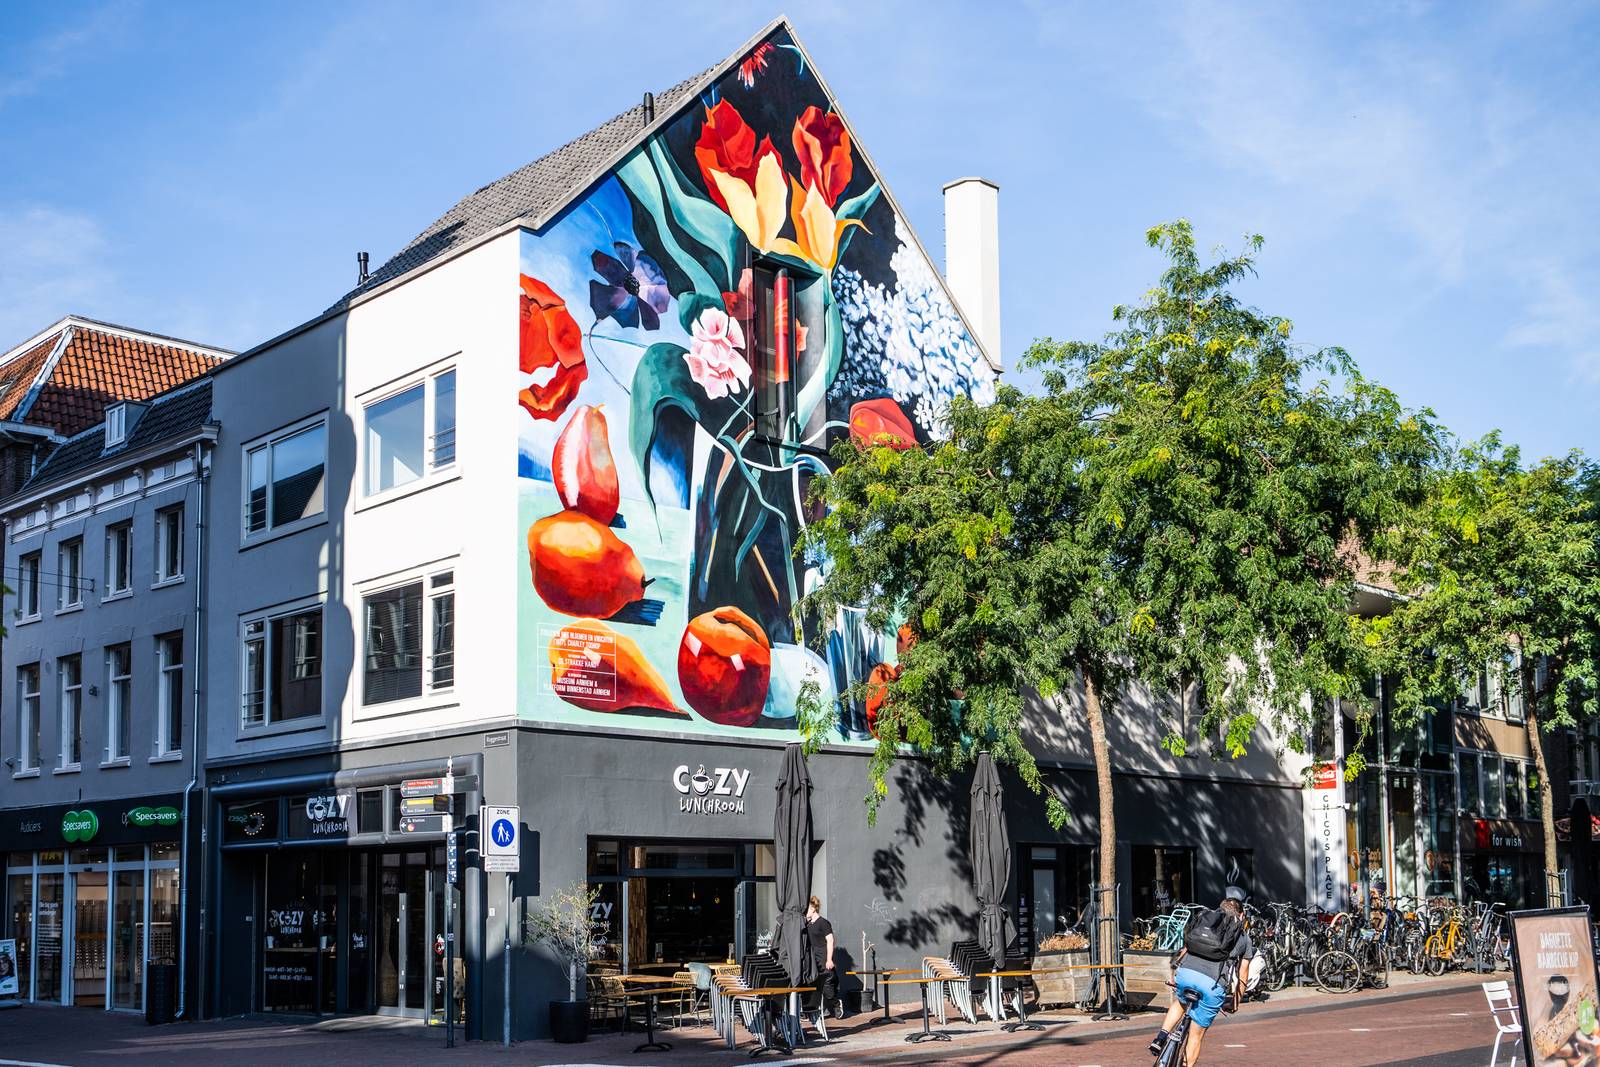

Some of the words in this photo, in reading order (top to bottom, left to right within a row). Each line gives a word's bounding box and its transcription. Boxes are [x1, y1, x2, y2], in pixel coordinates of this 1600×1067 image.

[576, 679, 594, 688] ARNHEM
[593, 688, 611, 696] ARNHEM
[673, 764, 751, 798] COZY
[306, 794, 353, 822] COZY
[680, 797, 745, 816] LUNCHROOM
[134, 812, 178, 823] Specsavers
[1322, 794, 1331, 851] CHICO'S
[62, 821, 92, 833] Specsavers
[312, 821, 350, 835] LUNCHROOM
[1492, 833, 1503, 847] for
[1505, 834, 1523, 847] wish
[1568, 951, 1580, 969] KIP
